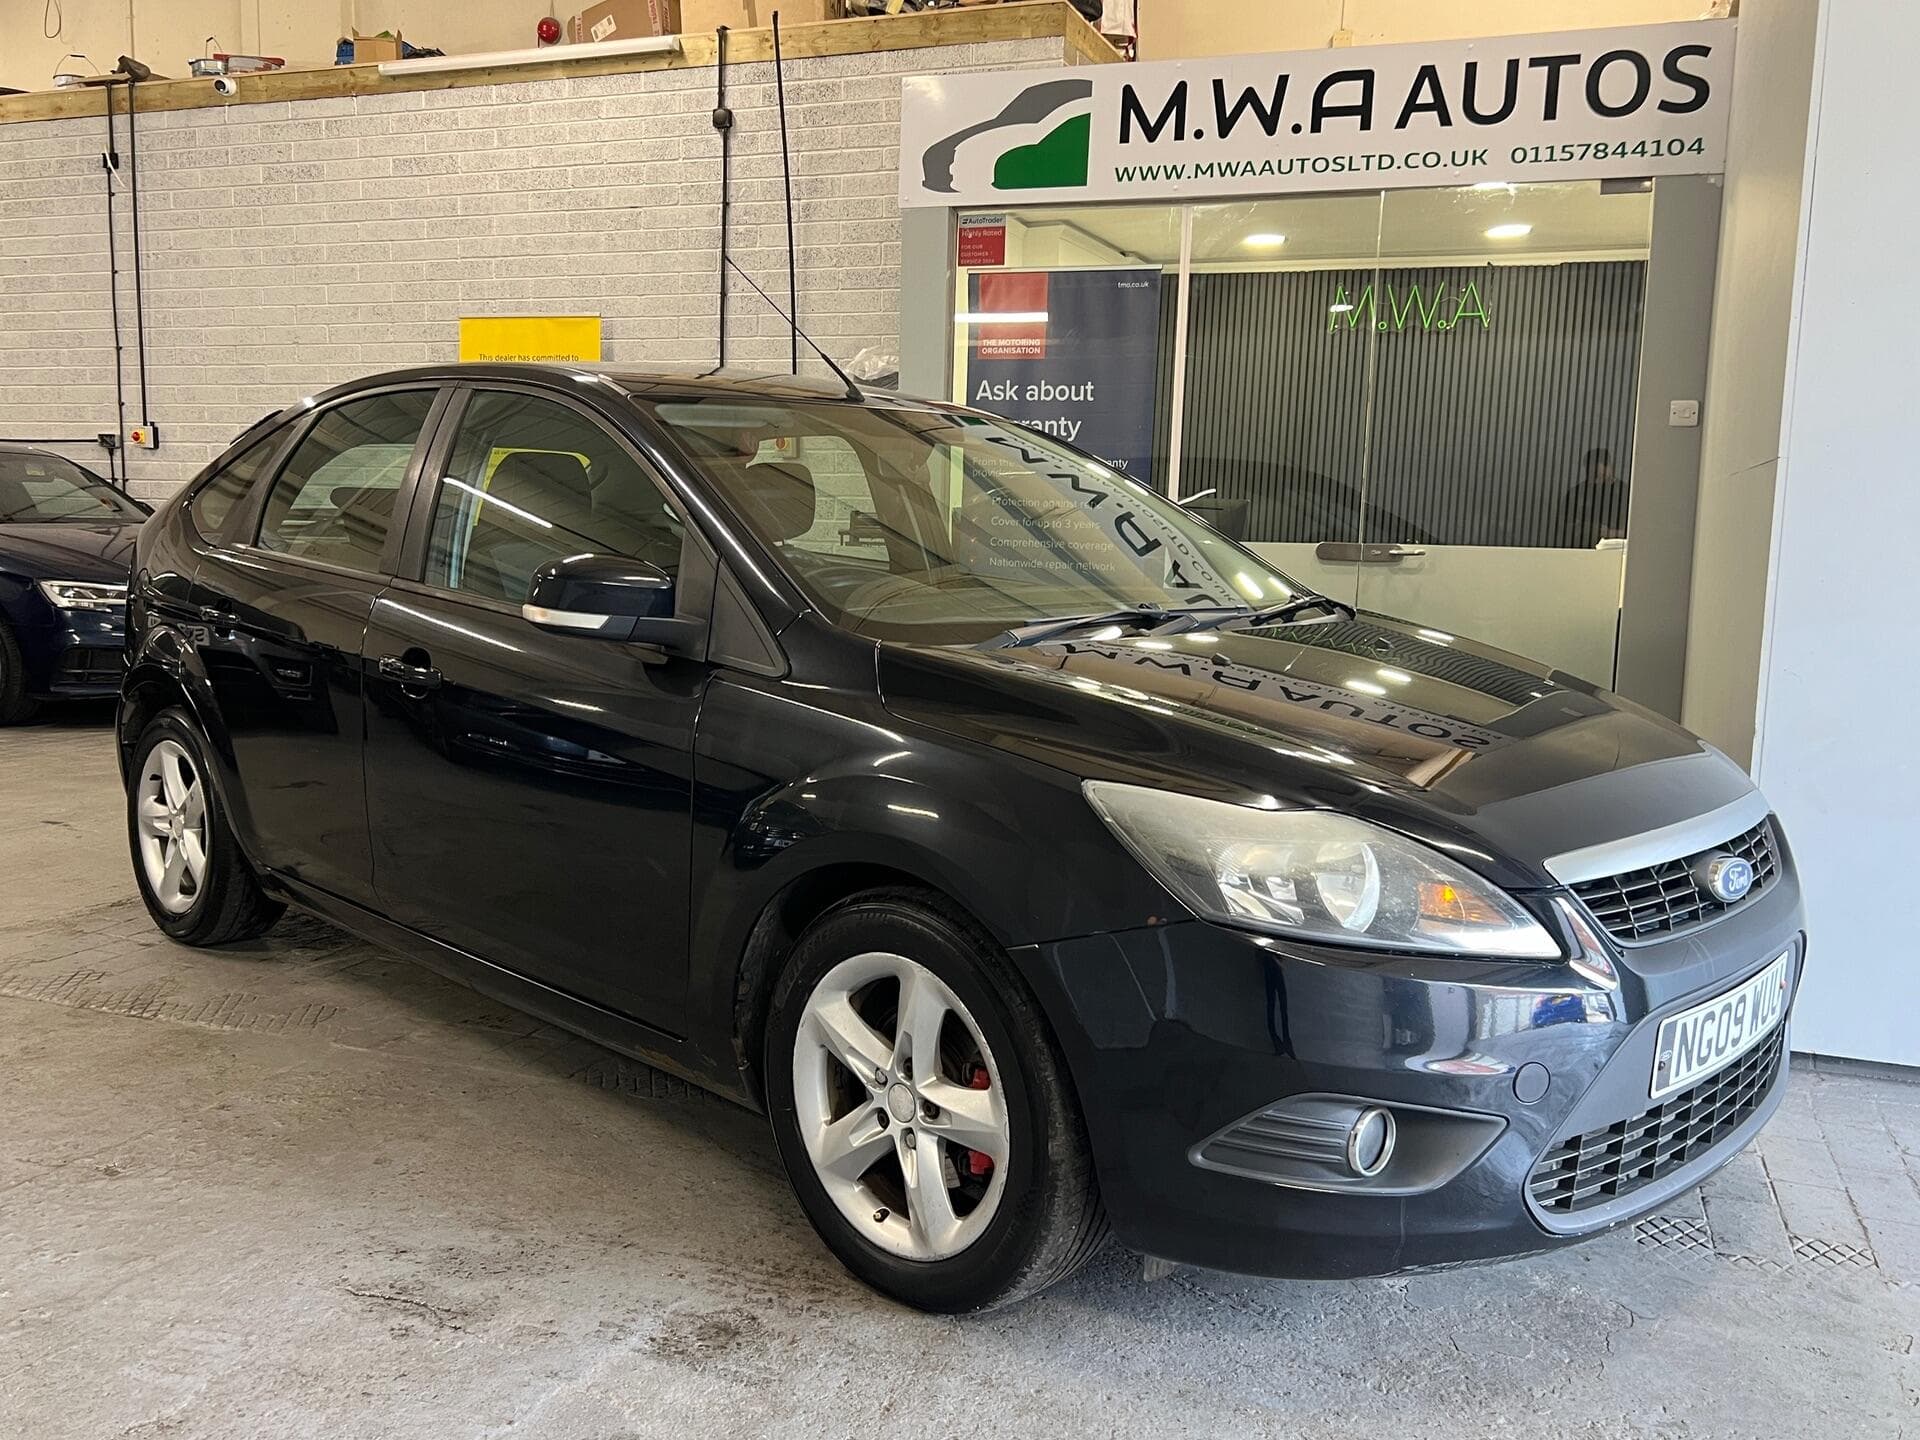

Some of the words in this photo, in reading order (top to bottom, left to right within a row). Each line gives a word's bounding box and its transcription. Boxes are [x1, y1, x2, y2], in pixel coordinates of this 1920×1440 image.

[1119, 69, 1375, 144] M.W.A
[1394, 45, 1713, 129] AUTOS
[1115, 149, 1489, 183] WWW.MWAAUTOSLTD.CO.UK
[1511, 137, 1706, 164] 01157844104
[1329, 281, 1489, 332] M.W.A
[480, 353, 493, 361] This
[495, 354, 516, 362] dealer
[518, 354, 530, 362] has
[532, 354, 570, 362] committed
[572, 354, 579, 362] to
[982, 346, 1041, 354] ORGANISATION
[976, 379, 1019, 401] Ask
[1026, 379, 1095, 401] about
[992, 496, 1040, 507] Protection
[1042, 499, 1078, 510] against
[991, 516, 1019, 526] Cover
[1022, 518, 1035, 527] for
[1037, 519, 1050, 529] up
[1052, 519, 1063, 529] to
[1065, 519, 1071, 529] 3
[1073, 520, 1101, 532] years
[990, 537, 1065, 549] Comprehensive
[1067, 541, 1114, 552] coverage
[989, 557, 1042, 569] Nationwide
[1045, 559, 1074, 570] repair
[1077, 561, 1116, 572] network
[1729, 867, 1748, 892] Ford
[1675, 993, 1747, 1078] NG09
